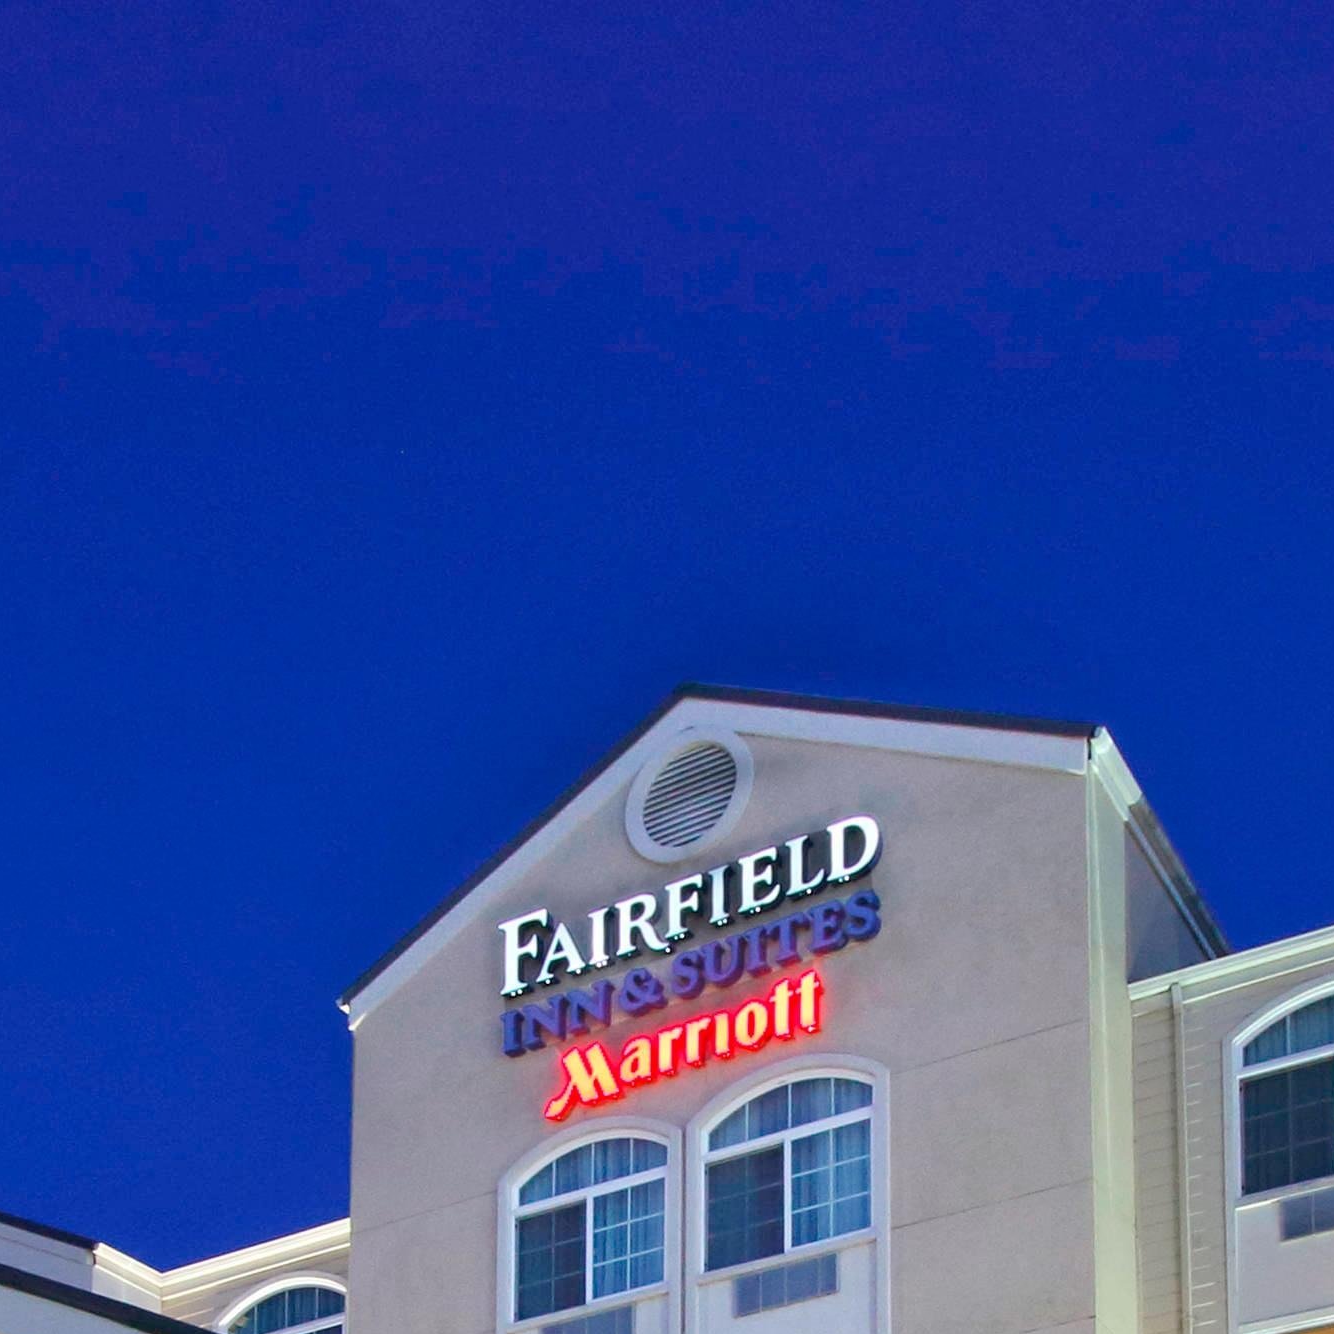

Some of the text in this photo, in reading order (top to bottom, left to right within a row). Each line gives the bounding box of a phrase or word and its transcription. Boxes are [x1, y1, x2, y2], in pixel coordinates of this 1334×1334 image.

[498, 815, 881, 997] FAIRFIELD
[500, 889, 881, 1056] INN & SUITES
[543, 969, 823, 1121] Marriott
